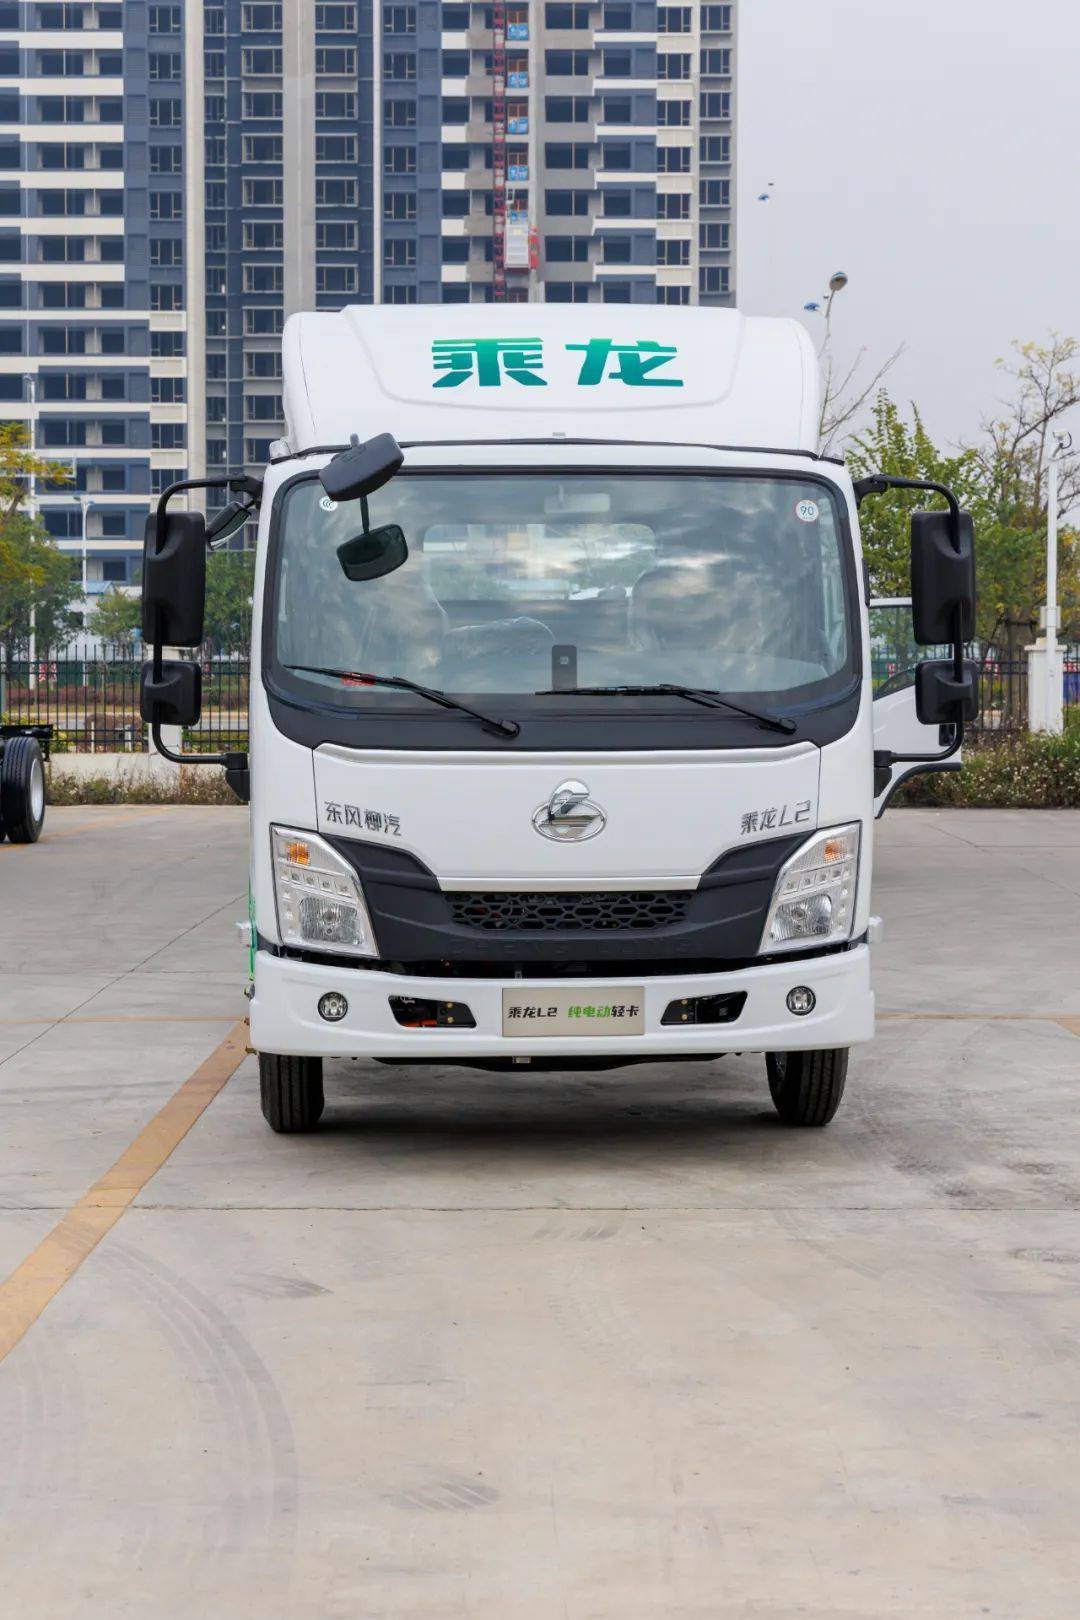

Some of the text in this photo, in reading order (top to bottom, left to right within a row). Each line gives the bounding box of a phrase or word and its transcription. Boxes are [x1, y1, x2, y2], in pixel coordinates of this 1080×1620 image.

[432, 337, 684, 388] 乘龙
[800, 505, 814, 516] 90
[324, 801, 402, 836] 东风柳汽
[740, 800, 811, 835] 乘龙L2
[508, 1005, 639, 1018] 乘龙L2 纯电动轻卡
